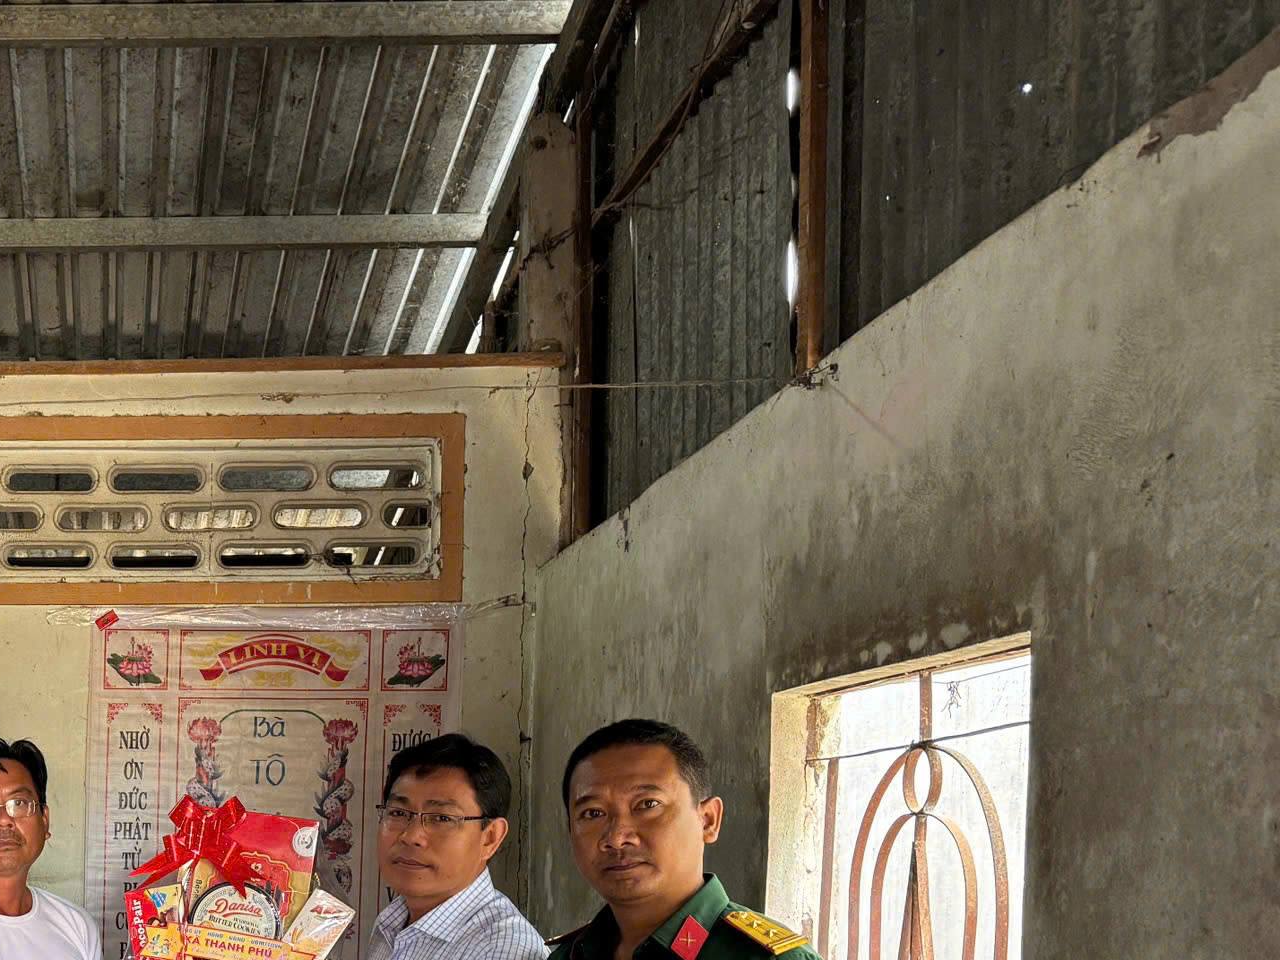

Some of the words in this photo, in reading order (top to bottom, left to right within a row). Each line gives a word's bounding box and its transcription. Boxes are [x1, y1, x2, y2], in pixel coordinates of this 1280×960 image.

[227, 643, 288, 664] LINH
[297, 646, 322, 667] VỊ
[119, 726, 150, 750] NHỜ
[253, 716, 286, 738] Bà
[124, 758, 144, 780] ƠN
[250, 753, 286, 786] TÔ
[118, 787, 147, 810] ĐỨC
[113, 817, 151, 844] PHẬT
[208, 898, 262, 917] Danisa
[205, 938, 245, 953] THẠNH
[248, 946, 272, 958] PHÚ
